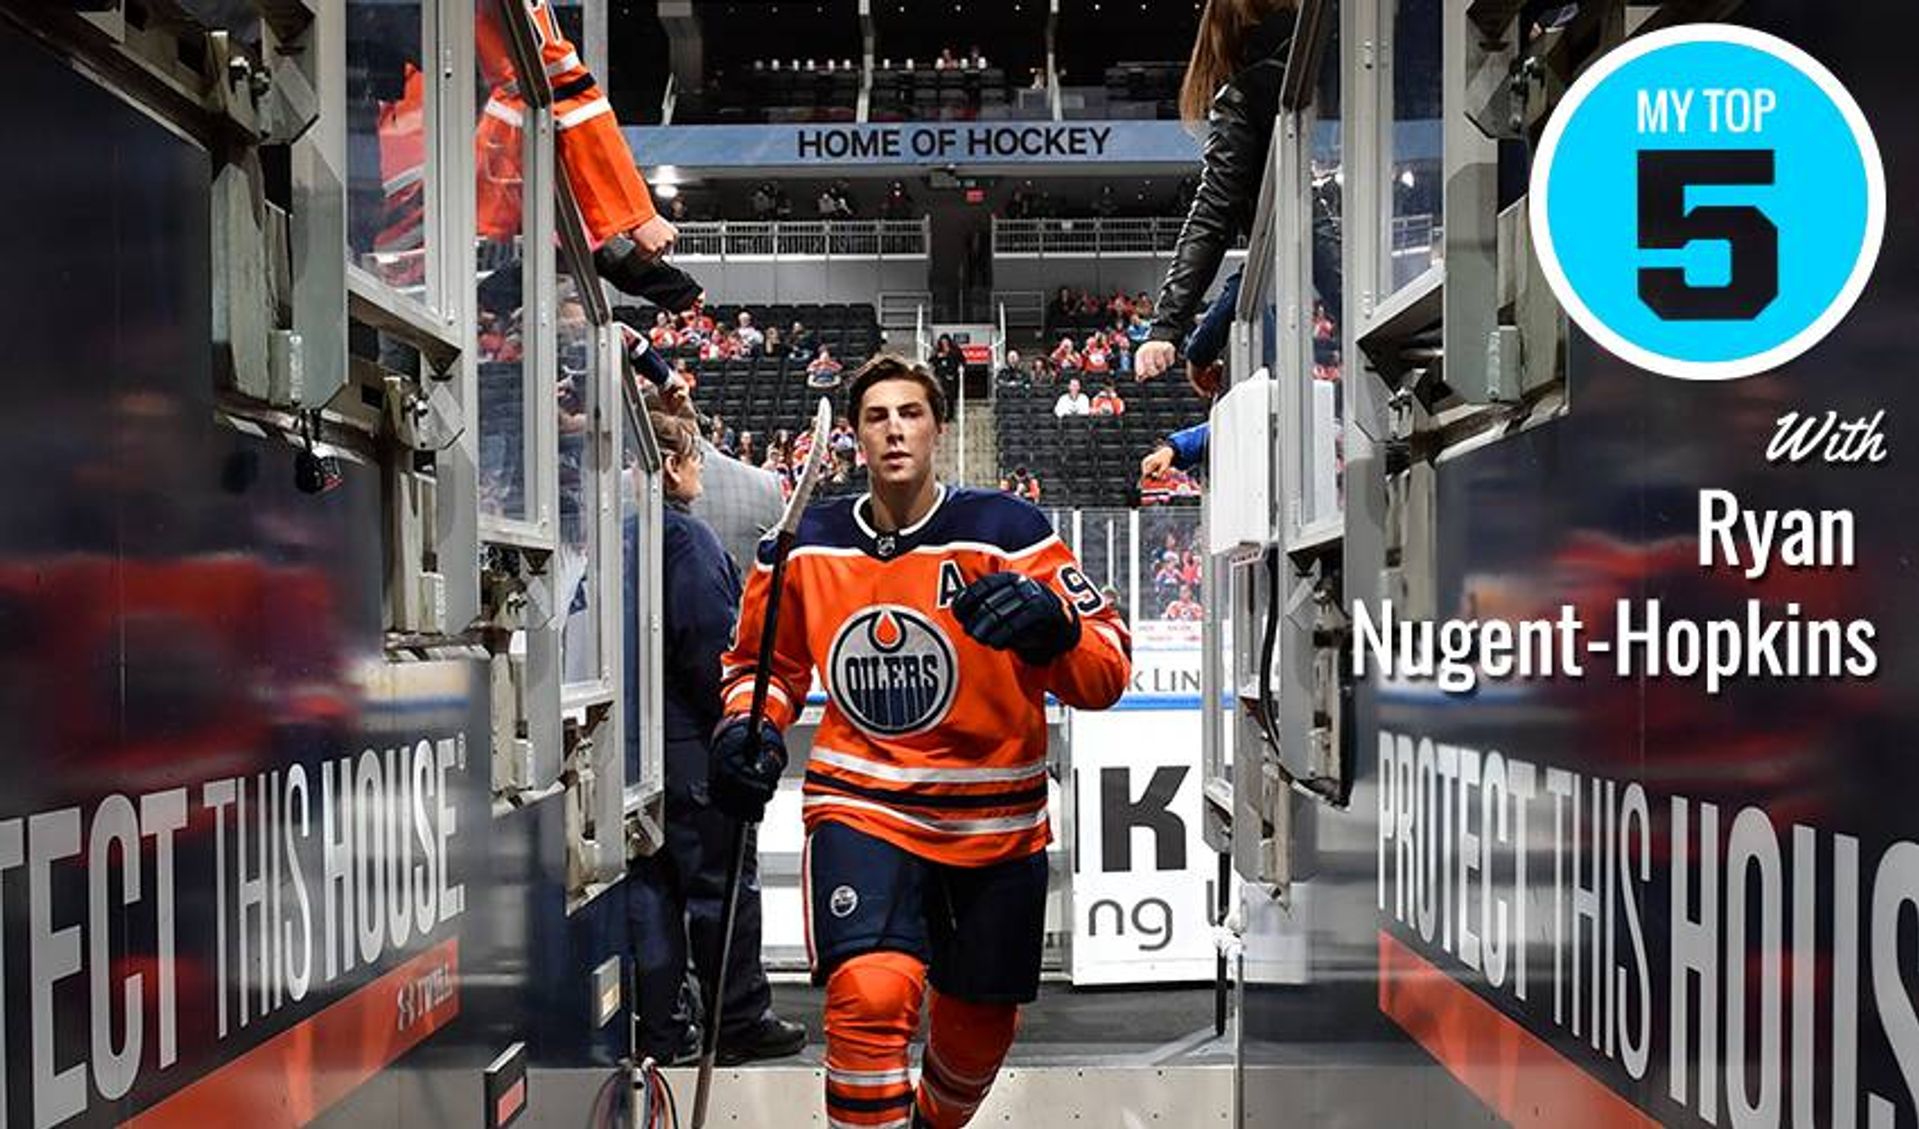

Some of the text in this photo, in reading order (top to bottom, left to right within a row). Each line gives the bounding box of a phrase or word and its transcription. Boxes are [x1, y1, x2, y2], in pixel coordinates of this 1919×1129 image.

[798, 126, 1111, 158] HOME OF HOCKEY
[936, 560, 967, 608] A
[844, 654, 940, 727] OILERS
[1074, 765, 1191, 874] K
[203, 763, 311, 1039] THIS
[1378, 731, 1536, 1001] PROTECT
[1547, 767, 1651, 1080] THIS
